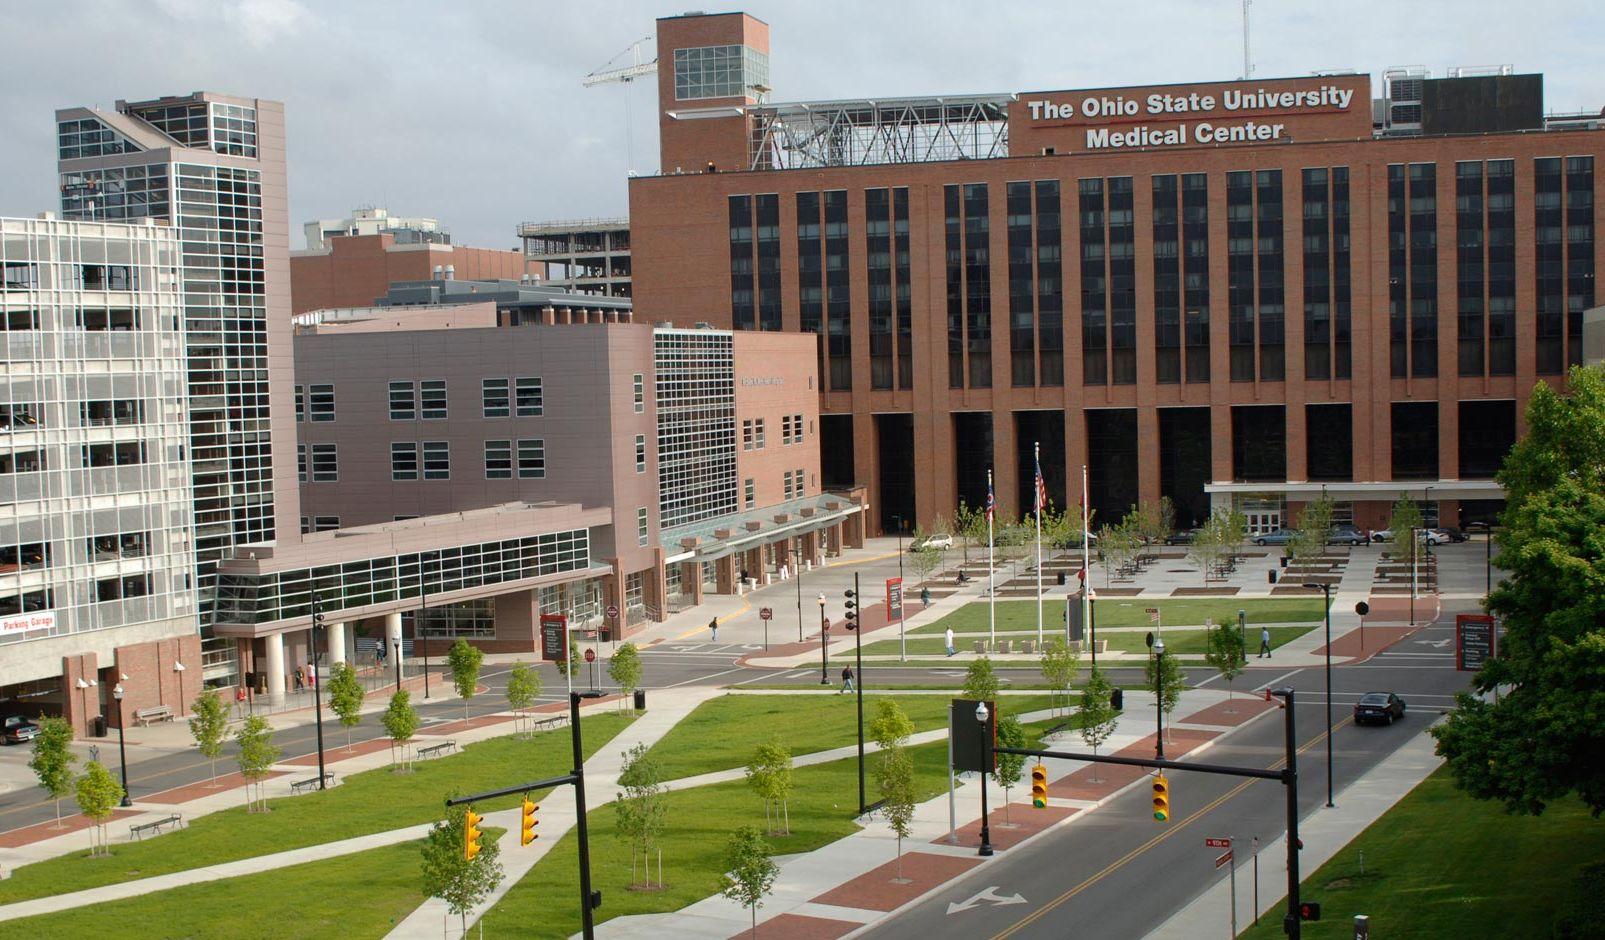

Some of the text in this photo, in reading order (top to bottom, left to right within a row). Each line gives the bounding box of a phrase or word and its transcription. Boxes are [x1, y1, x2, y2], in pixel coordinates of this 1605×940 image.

[1028, 85, 1354, 120] The Ohio State University
[1087, 121, 1284, 149] Medical Center
[3, 616, 53, 630] Parking Garage
